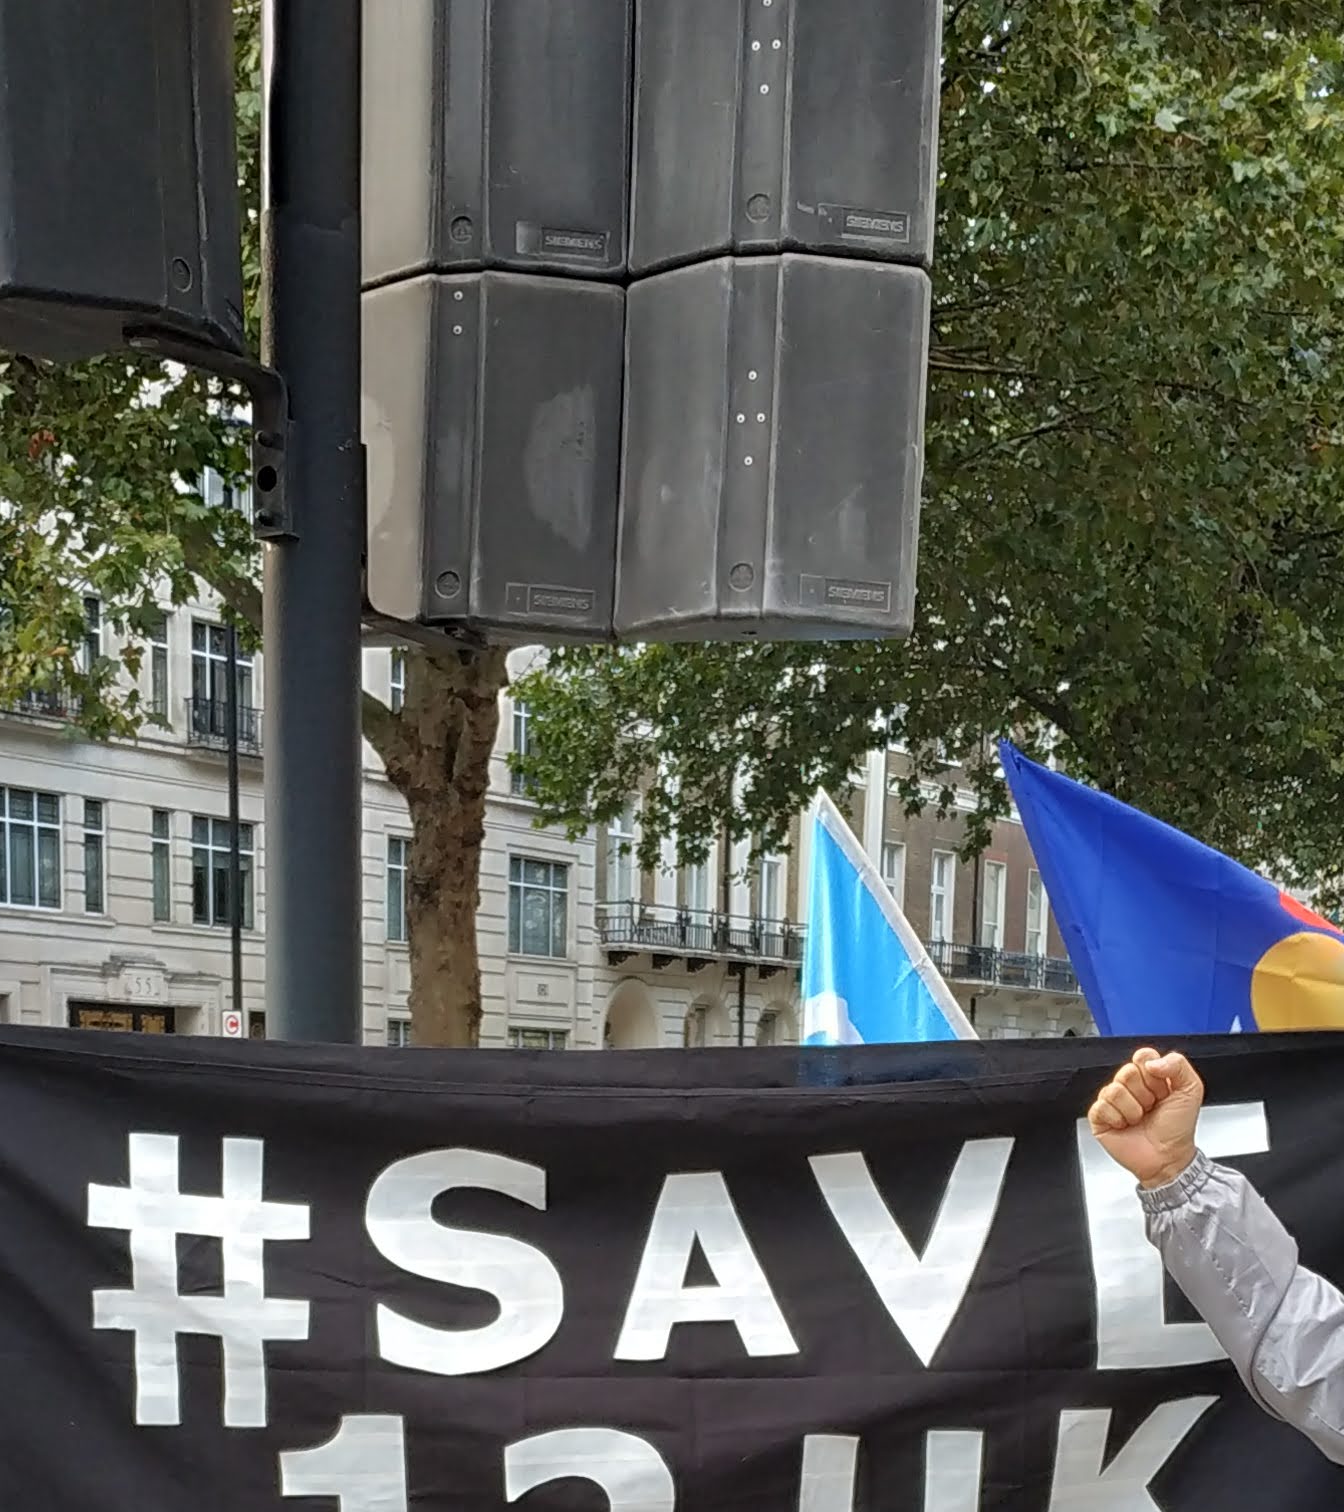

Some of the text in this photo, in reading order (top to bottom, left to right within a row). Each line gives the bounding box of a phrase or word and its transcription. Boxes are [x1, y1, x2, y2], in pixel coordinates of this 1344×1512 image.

[846, 214, 904, 233] SIEMENS
[544, 234, 603, 250] SIEMENS
[533, 593, 591, 610] SIEMENS
[827, 585, 885, 602] SIEMENS
[87, 1100, 1270, 1428] #SAVE
